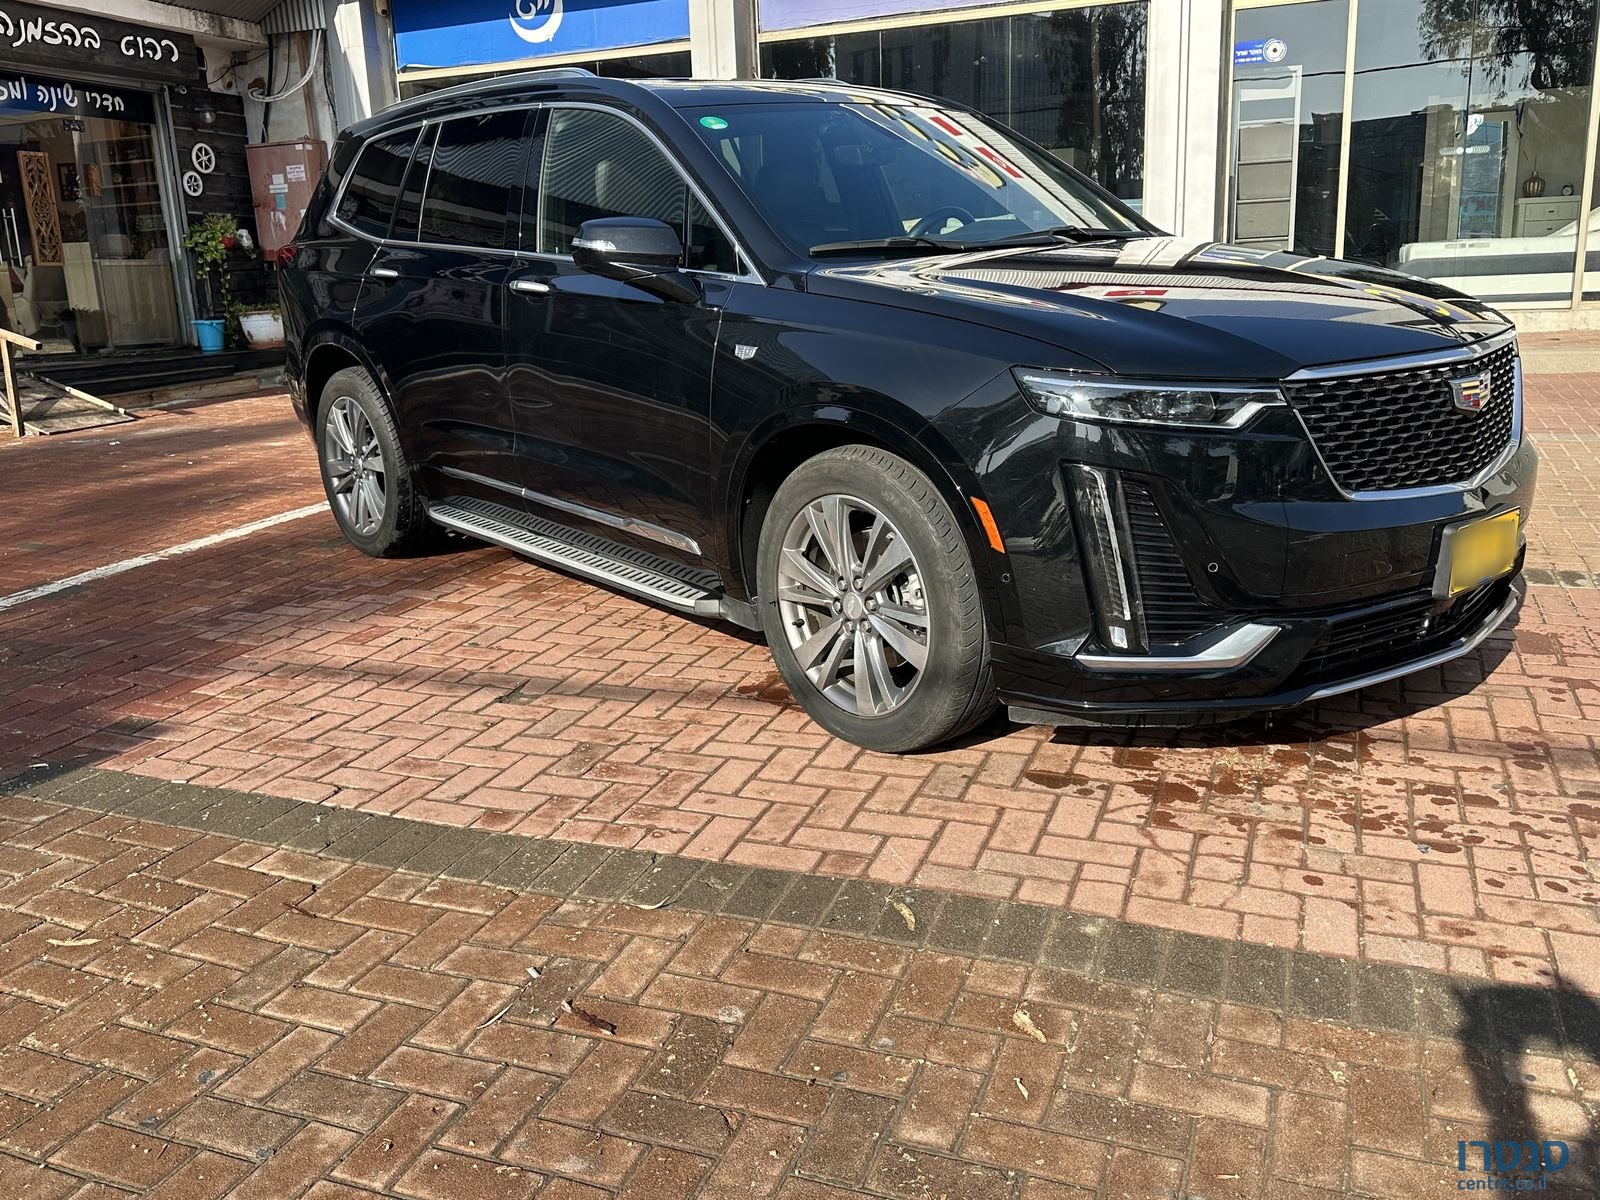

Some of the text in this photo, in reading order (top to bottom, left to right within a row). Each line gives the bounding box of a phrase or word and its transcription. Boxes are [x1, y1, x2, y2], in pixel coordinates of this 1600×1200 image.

[120, 35, 179, 62] רהוט
[37, 83, 78, 112] שינה
[85, 91, 125, 112] חדרי
